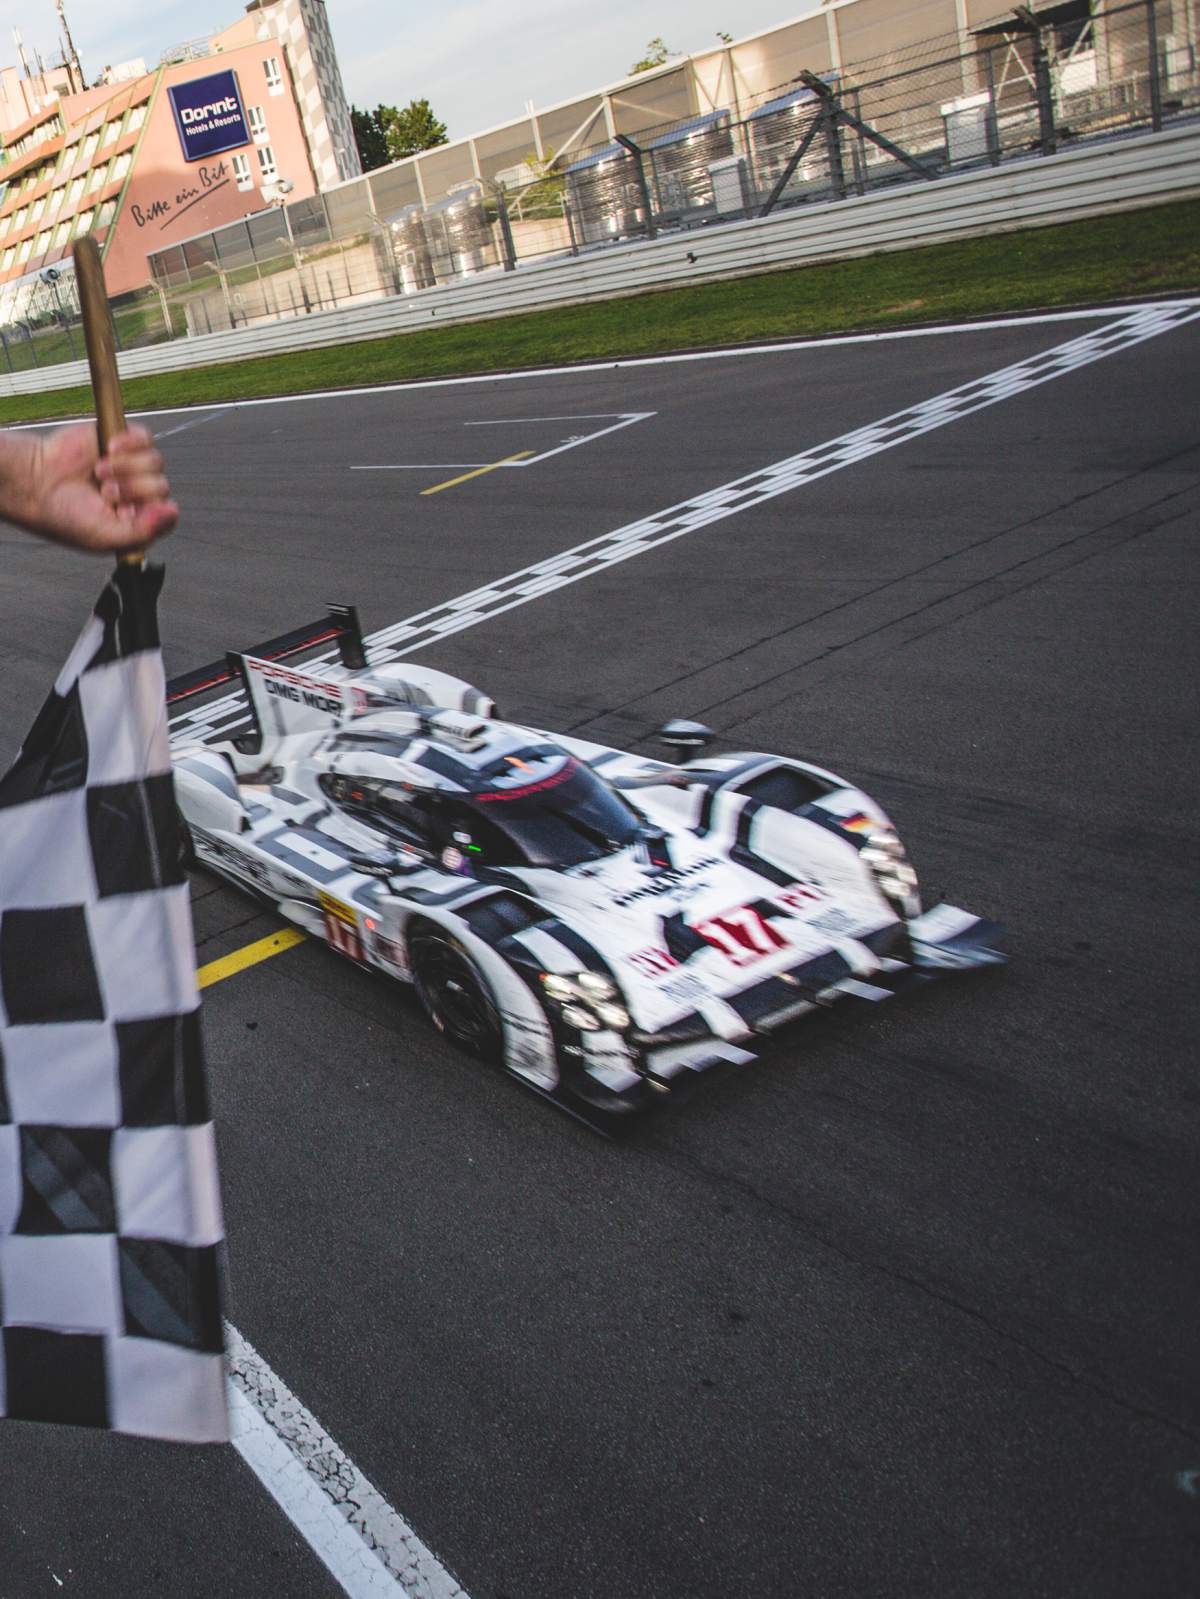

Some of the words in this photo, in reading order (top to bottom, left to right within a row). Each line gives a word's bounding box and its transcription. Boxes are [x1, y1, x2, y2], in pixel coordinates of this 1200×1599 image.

[180, 97, 238, 125] Dorint
[186, 123, 209, 136] Hotels
[208, 119, 215, 130] &
[214, 114, 241, 128] Resorts
[131, 204, 171, 227] Bitte
[176, 188, 199, 204] ein
[198, 161, 229, 188] Bit
[248, 660, 343, 698] PORSCHE
[696, 905, 788, 965] 17
